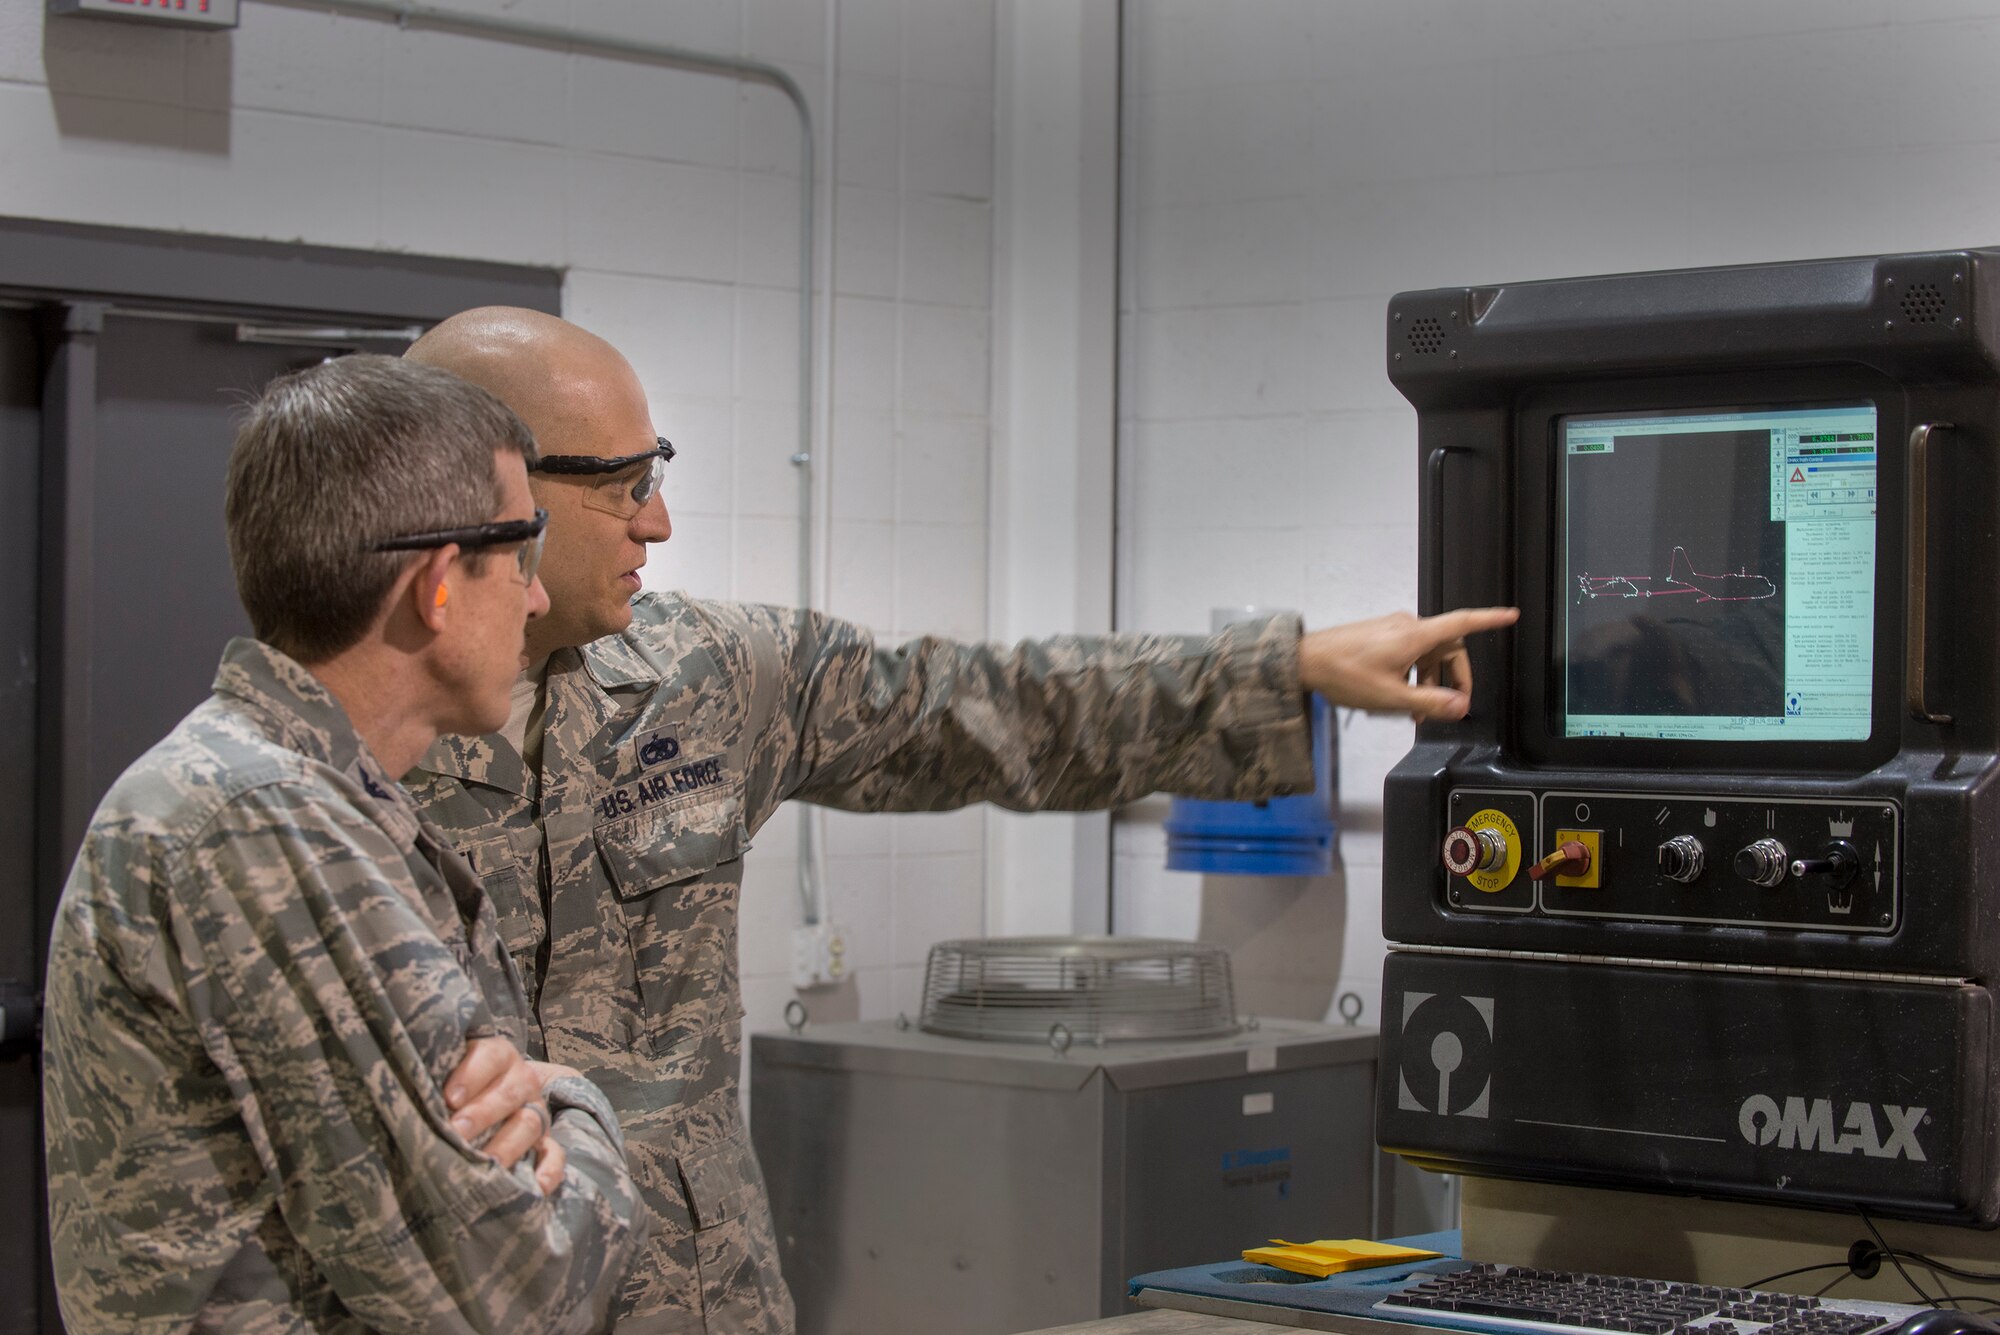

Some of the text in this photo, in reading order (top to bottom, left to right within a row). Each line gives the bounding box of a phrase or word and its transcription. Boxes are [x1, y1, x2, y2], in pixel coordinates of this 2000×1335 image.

[601, 759, 723, 819] U.S. AIR FORCE
[1450, 831, 1469, 842] STOP
[1476, 876, 1499, 888] STOP
[1738, 1094, 1928, 1161] OMAX
